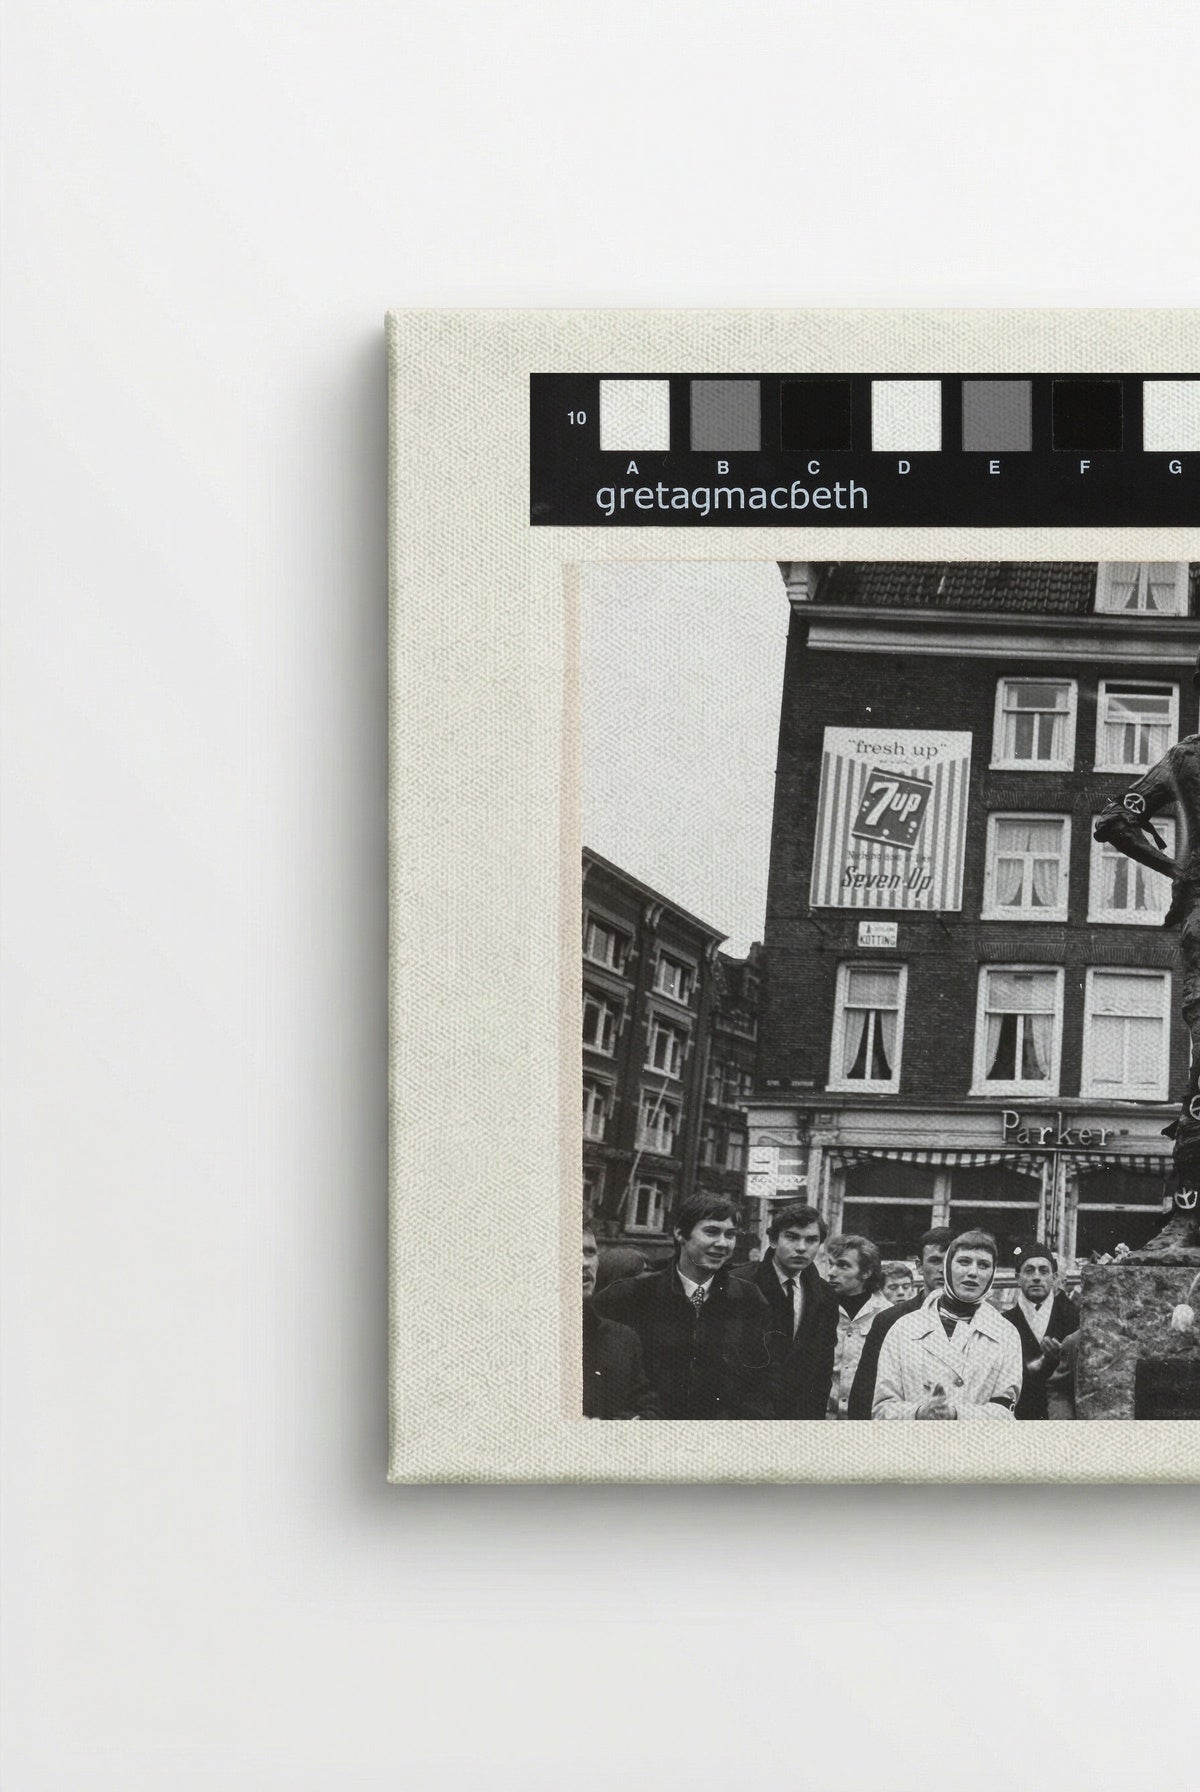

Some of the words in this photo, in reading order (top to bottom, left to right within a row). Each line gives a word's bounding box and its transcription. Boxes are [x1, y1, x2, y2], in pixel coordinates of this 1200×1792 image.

[567, 410, 587, 425] 10
[626, 460, 640, 474] A
[716, 460, 730, 474] B
[806, 460, 821, 474] C
[898, 460, 912, 474] D
[989, 460, 1002, 474] E
[1080, 460, 1091, 474] F
[1168, 460, 1183, 474] G
[596, 480, 868, 516] gretagmacbeth
[1001, 1109, 1114, 1146] Parker
